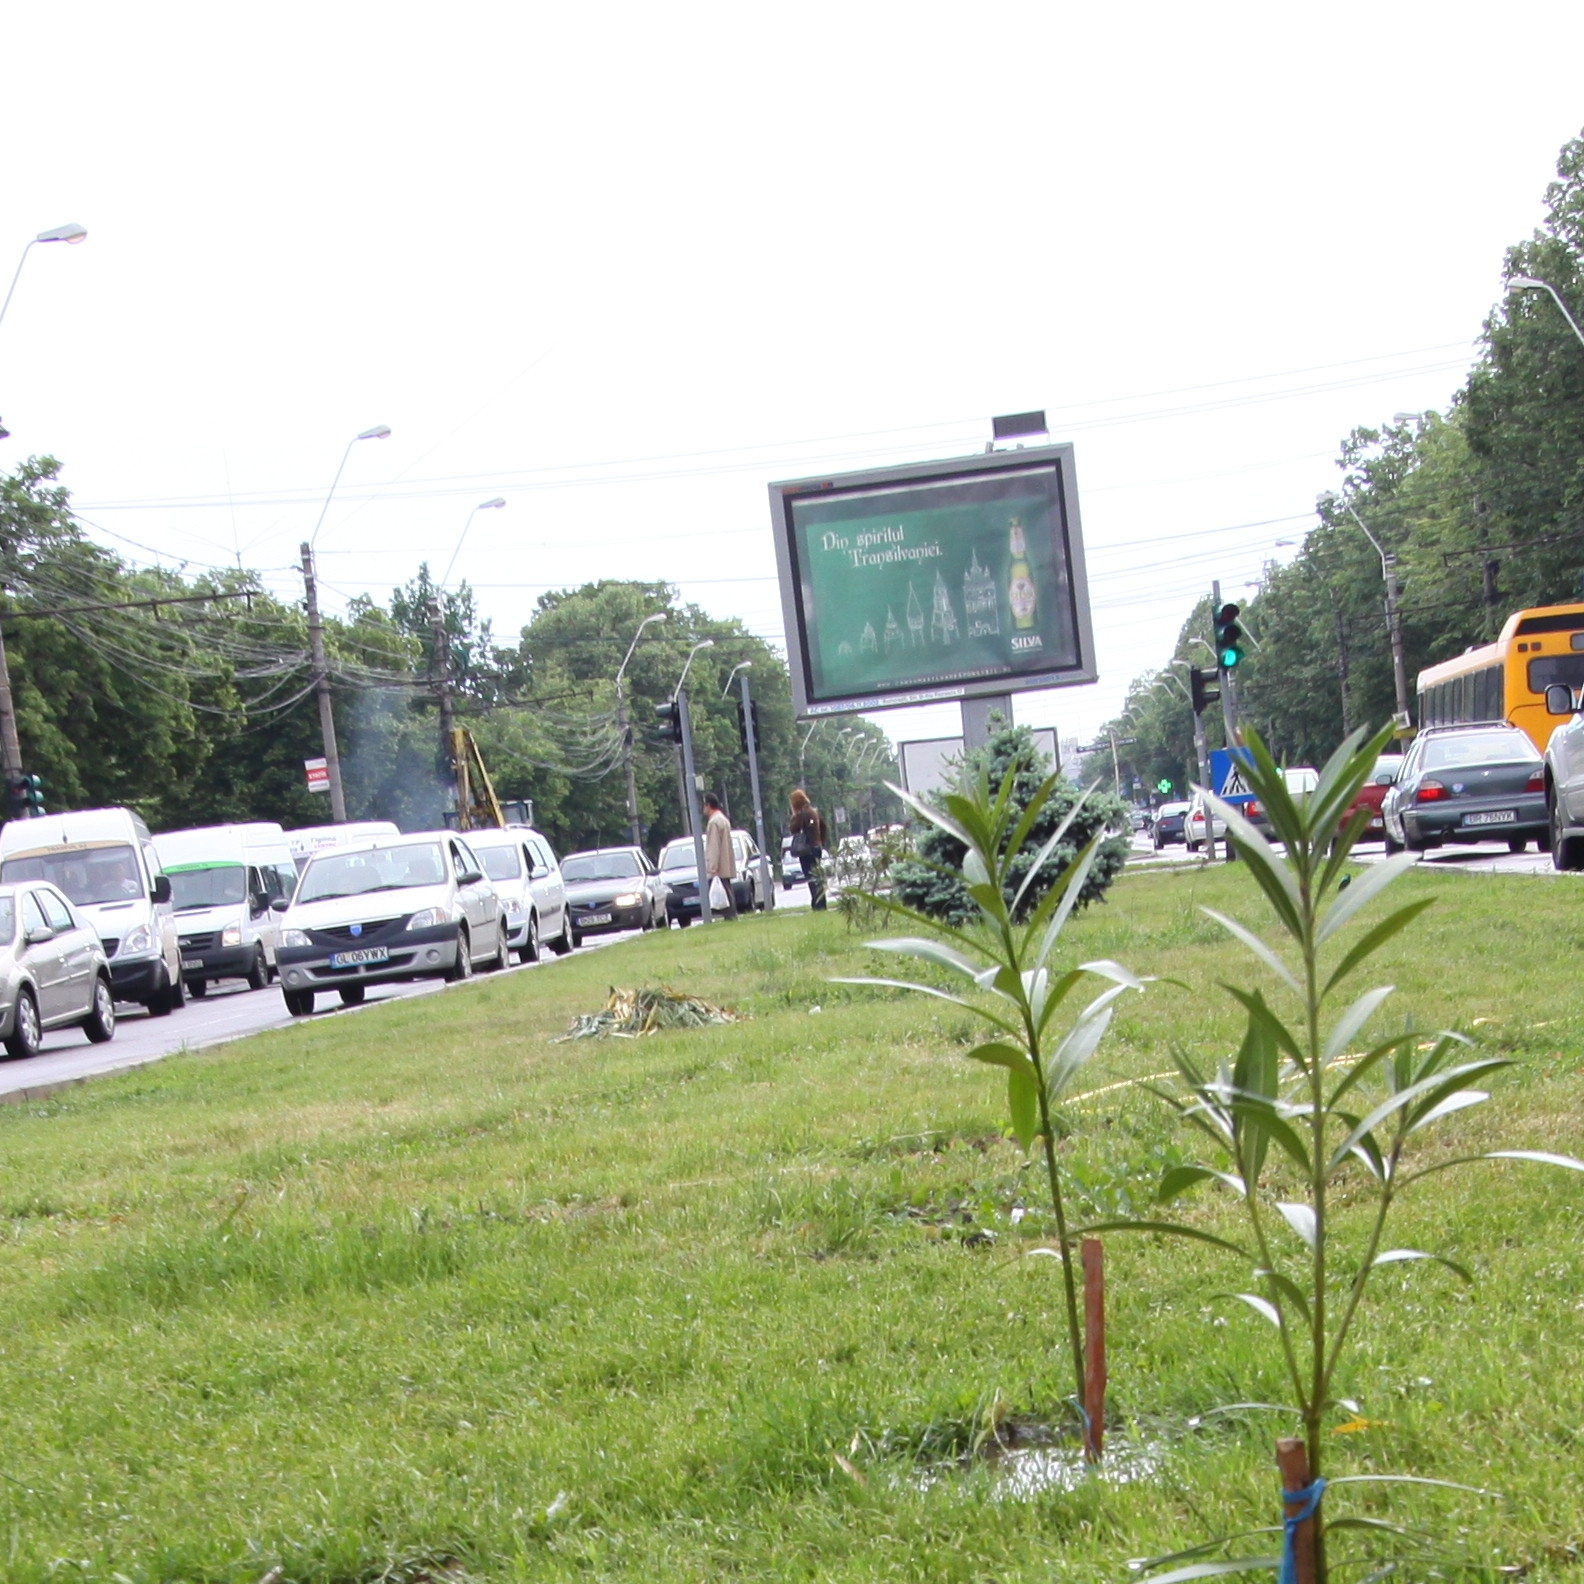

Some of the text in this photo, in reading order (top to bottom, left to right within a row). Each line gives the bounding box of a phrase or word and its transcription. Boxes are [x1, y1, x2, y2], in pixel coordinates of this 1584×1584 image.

[822, 524, 904, 554] Din spiritul
[1011, 635, 1043, 650] SILVA
